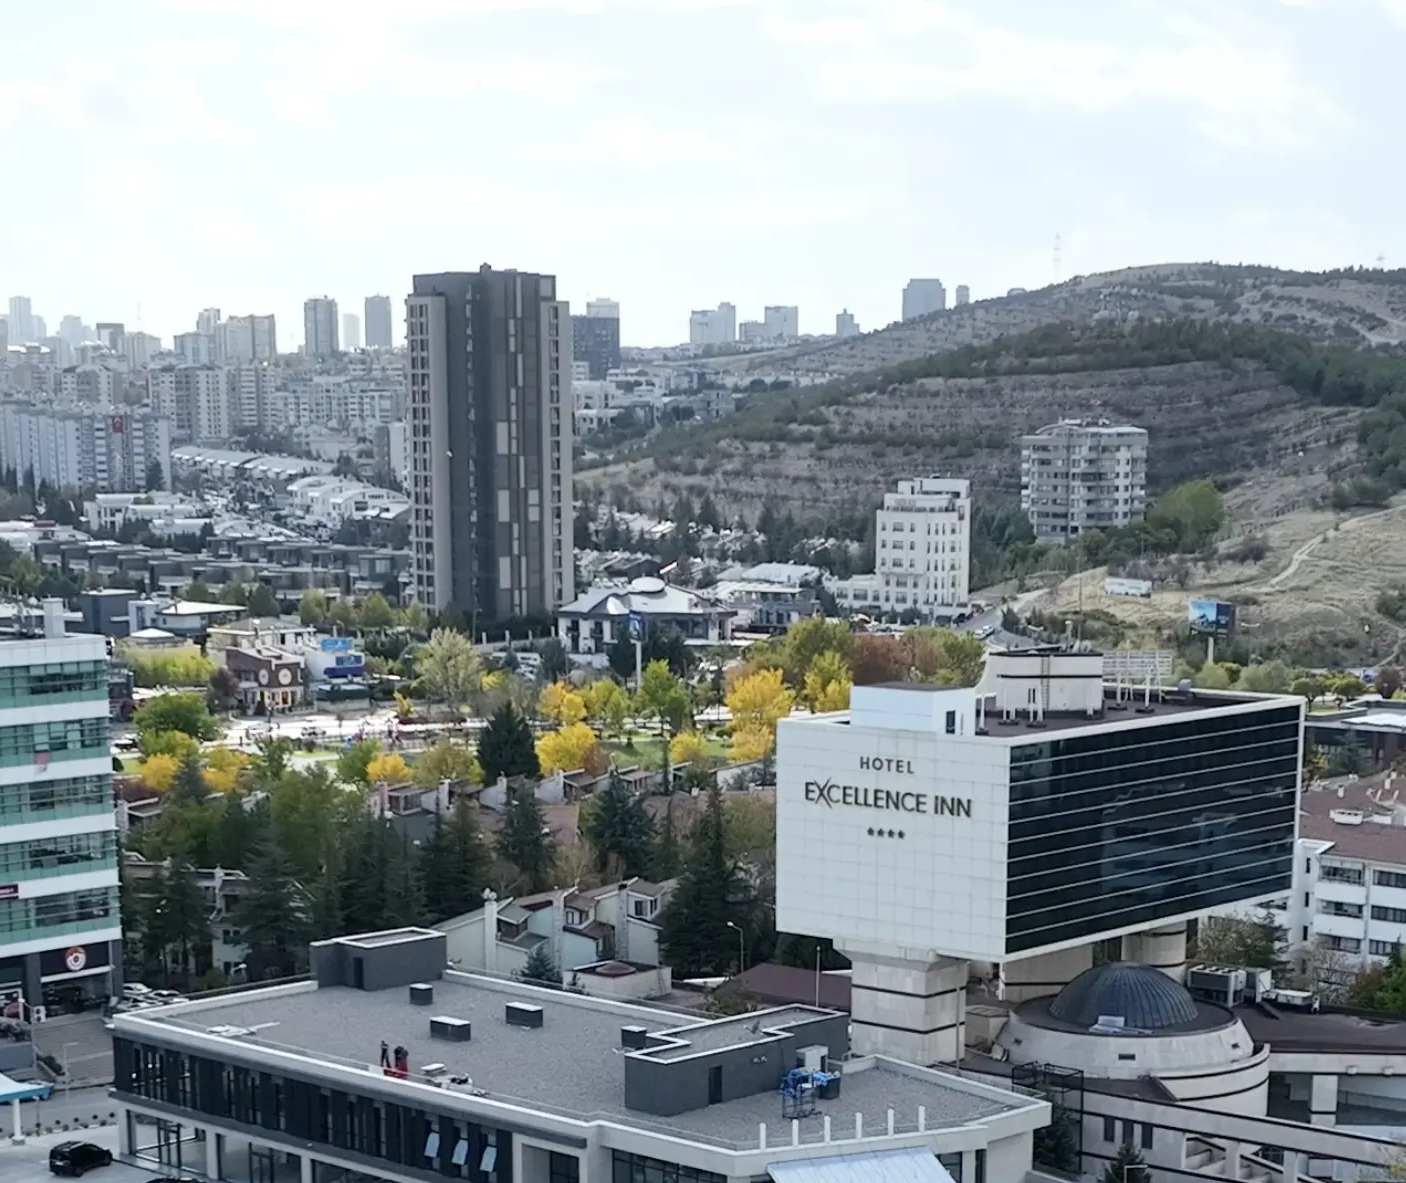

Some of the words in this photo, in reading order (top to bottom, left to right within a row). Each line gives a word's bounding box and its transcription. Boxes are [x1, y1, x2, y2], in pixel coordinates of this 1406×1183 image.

[859, 756, 915, 775] HOTEL
[804, 777, 928, 814] EXCELLENCE
[933, 795, 972, 818] INN
